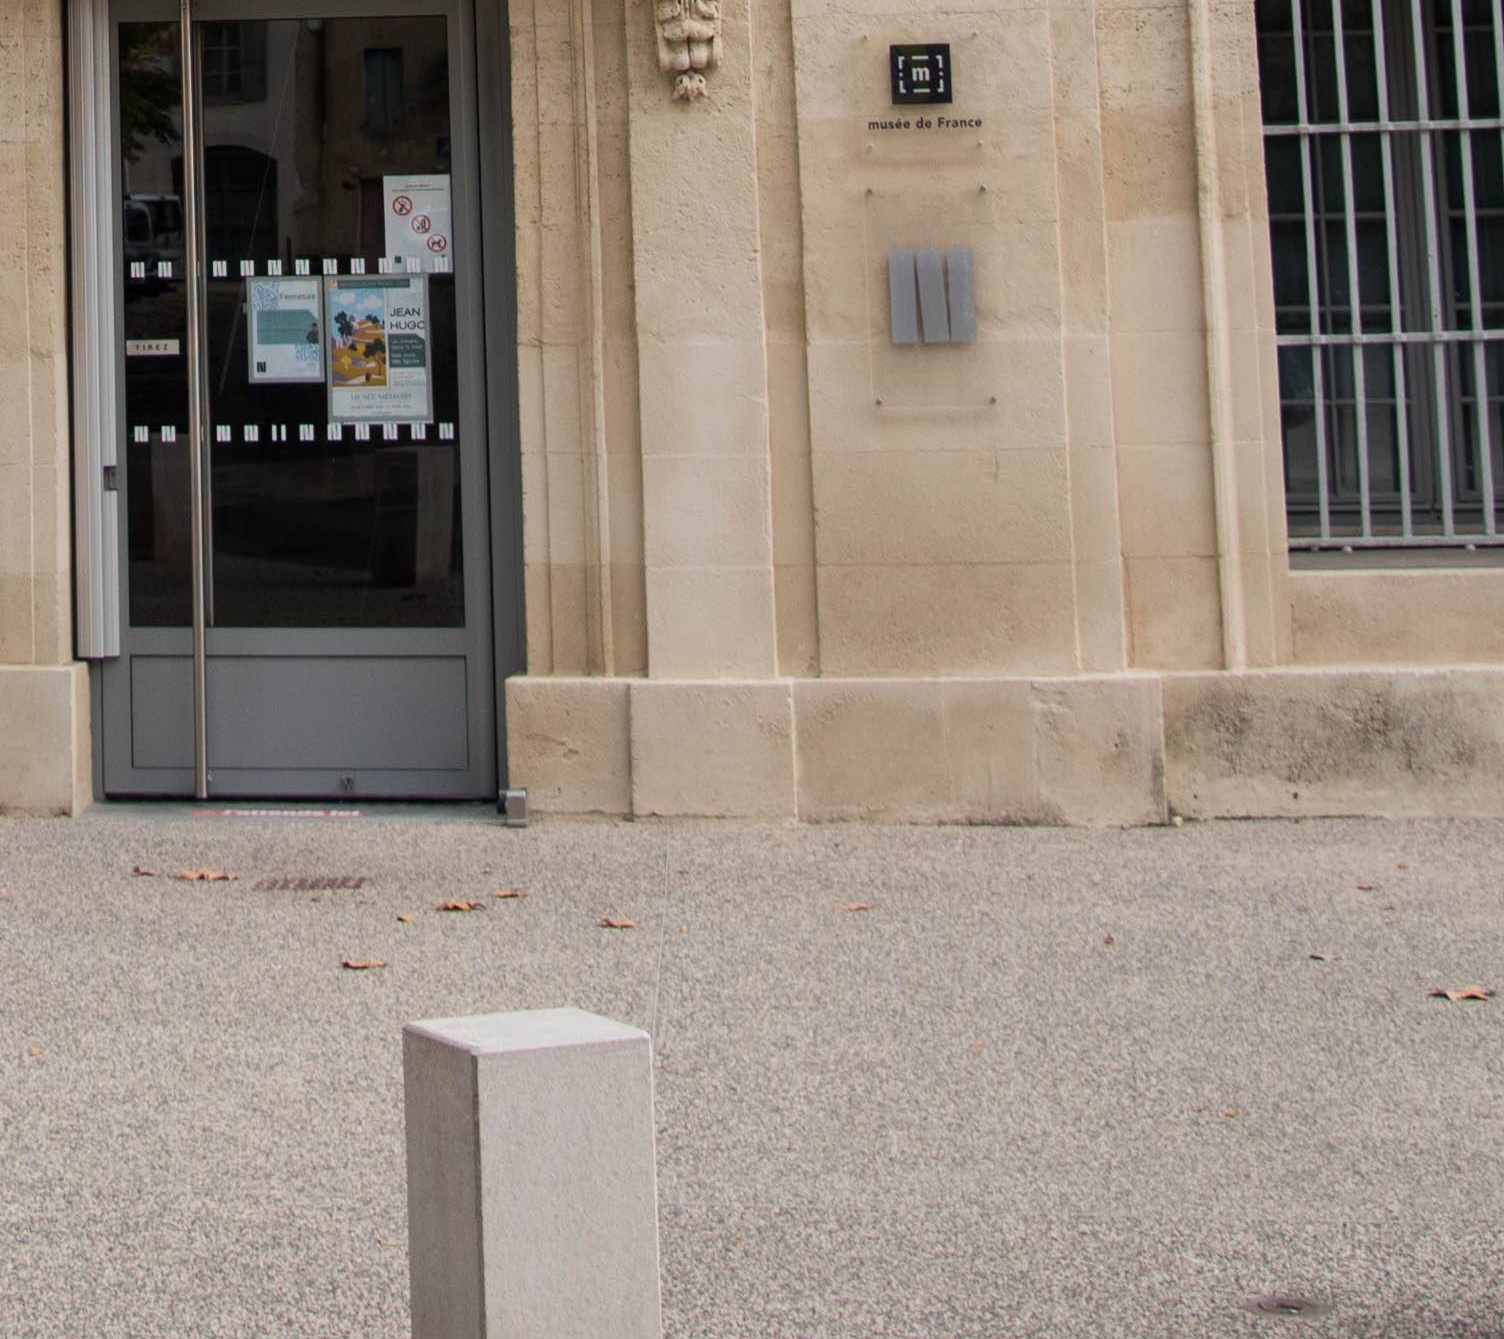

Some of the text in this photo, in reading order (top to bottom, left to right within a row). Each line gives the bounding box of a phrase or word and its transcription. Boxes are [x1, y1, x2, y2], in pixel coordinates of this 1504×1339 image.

[868, 116, 983, 131] musée de France
[390, 307, 421, 318] JEAN
[135, 343, 169, 351] TIREZ
